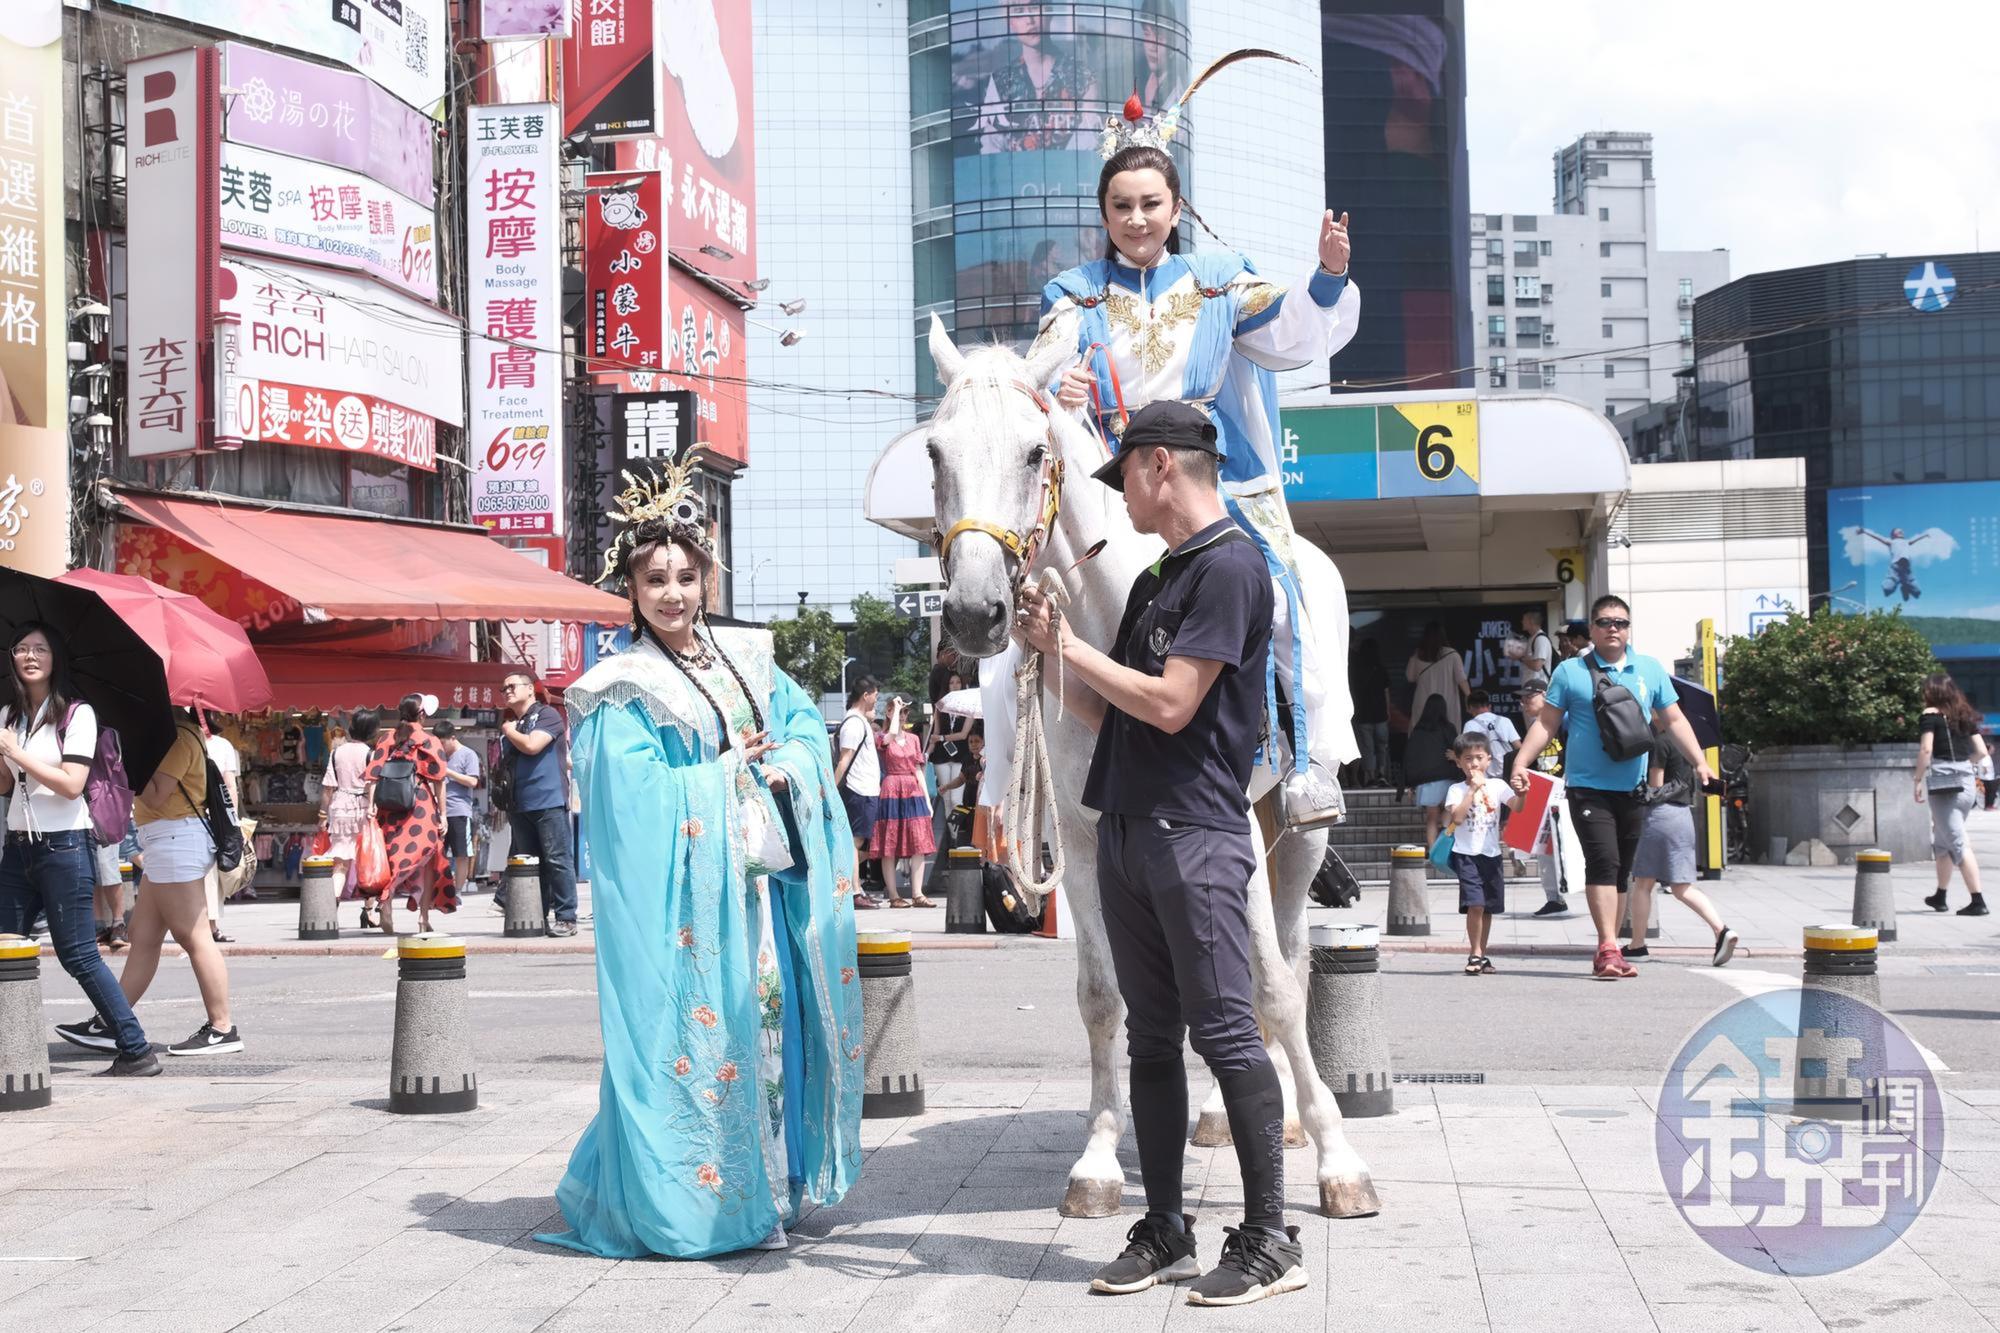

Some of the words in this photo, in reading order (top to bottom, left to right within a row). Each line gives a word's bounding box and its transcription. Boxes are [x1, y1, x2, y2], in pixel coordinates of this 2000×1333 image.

[280, 87, 357, 141] 湯の花
[477, 115, 544, 141] 玉芙蓉
[221, 164, 273, 214] 芙蓉
[278, 190, 302, 207] SPA
[308, 184, 363, 222] 按摩
[0, 92, 40, 347] 首選維格
[485, 168, 537, 259] 按摩
[485, 277, 538, 290] Massage
[496, 264, 526, 276] Body
[252, 282, 326, 325] 李奇
[609, 249, 641, 358] 小蒙牛
[252, 321, 325, 361] RICH
[486, 297, 538, 390] 護膚
[640, 351, 657, 364] 3F
[139, 336, 188, 434] 李奇
[499, 396, 528, 406] Face
[481, 408, 544, 421] Treatment
[624, 400, 679, 460] 請
[1416, 423, 1457, 482] 6
[477, 495, 549, 512] 0965-879-000
[1556, 558, 1575, 584] 6
[1478, 620, 1512, 638] JOKER
